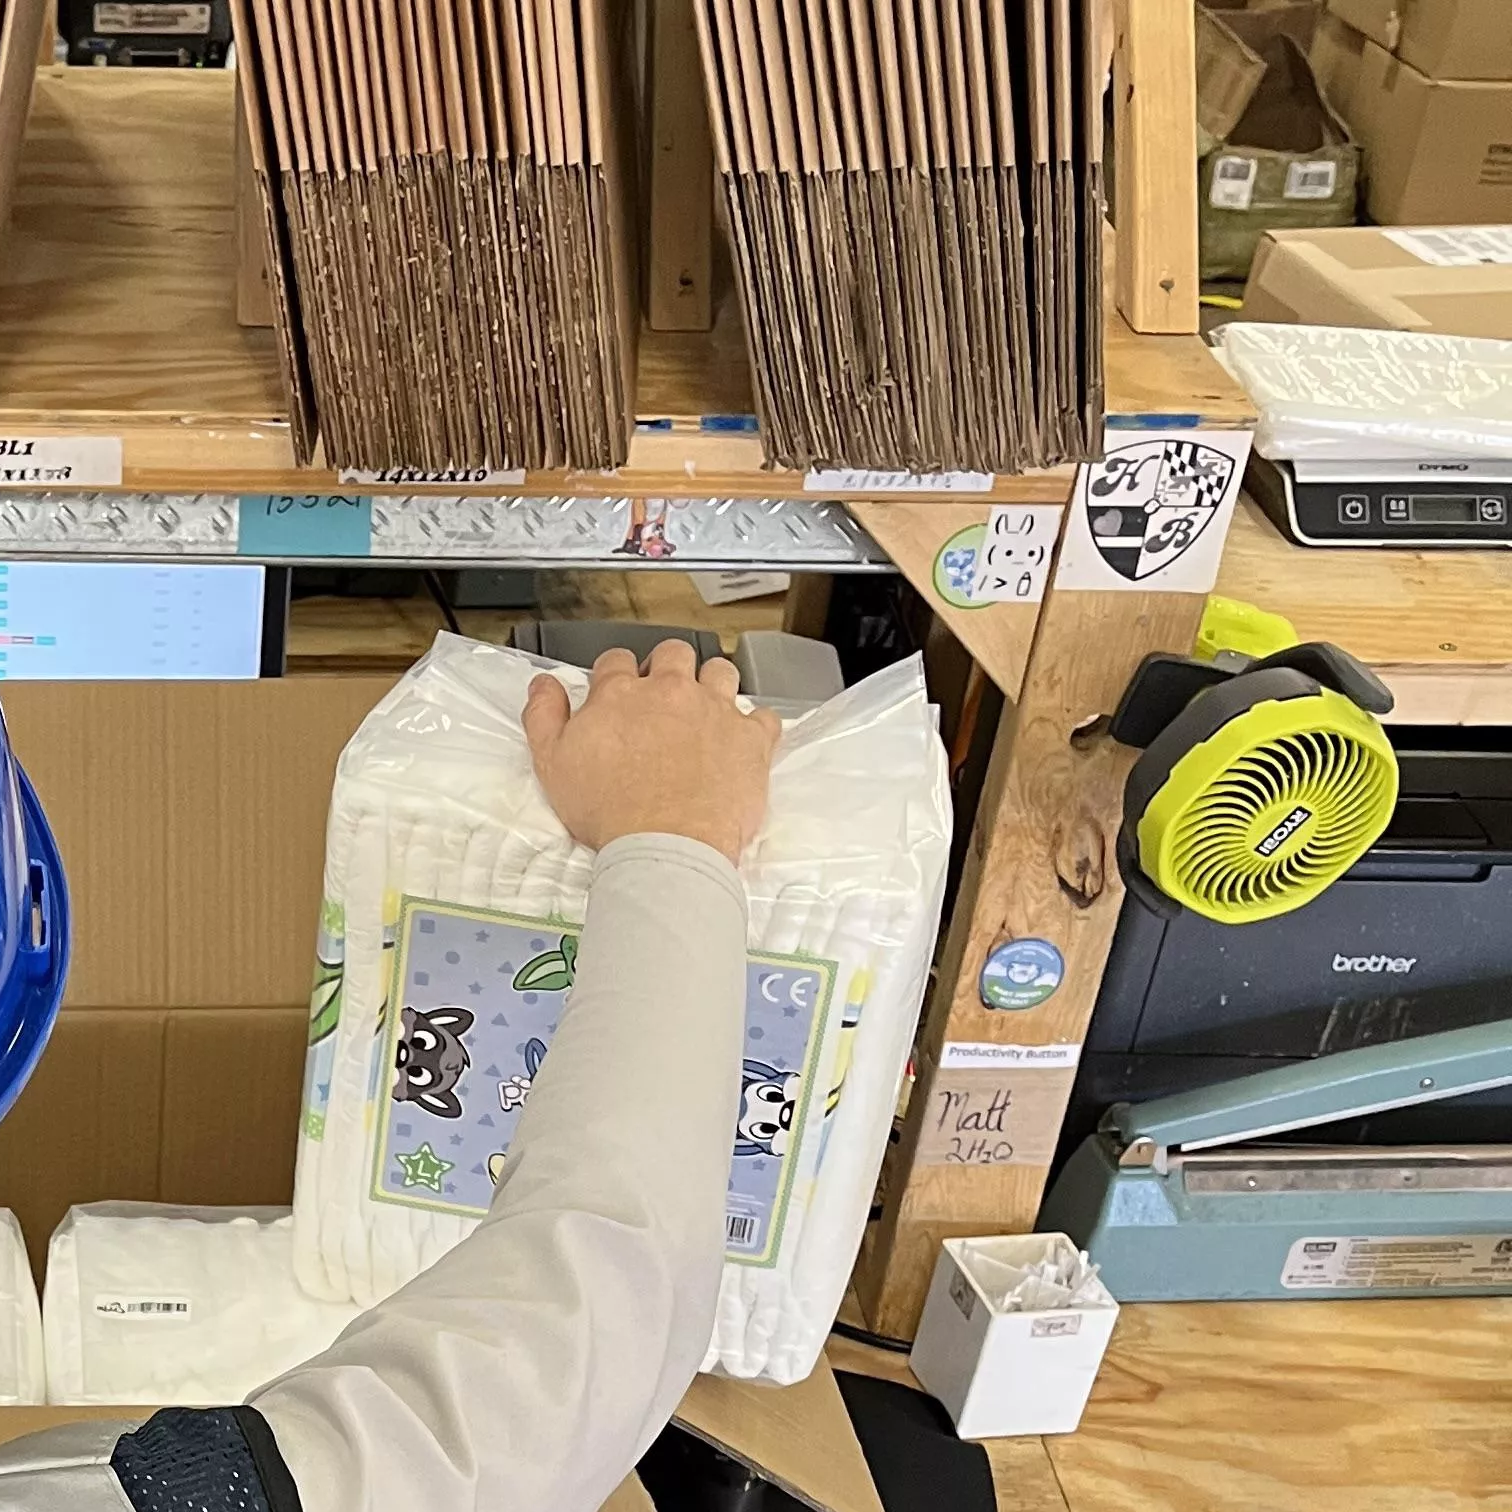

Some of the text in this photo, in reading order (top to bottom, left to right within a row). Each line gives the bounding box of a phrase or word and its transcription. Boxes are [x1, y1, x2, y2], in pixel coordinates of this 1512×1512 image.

[1258, 809, 1310, 855] RYOBI
[1332, 953, 1417, 973] brother
[949, 1046, 1068, 1060] Productivity Button
[937, 1089, 1012, 1132] Matt
